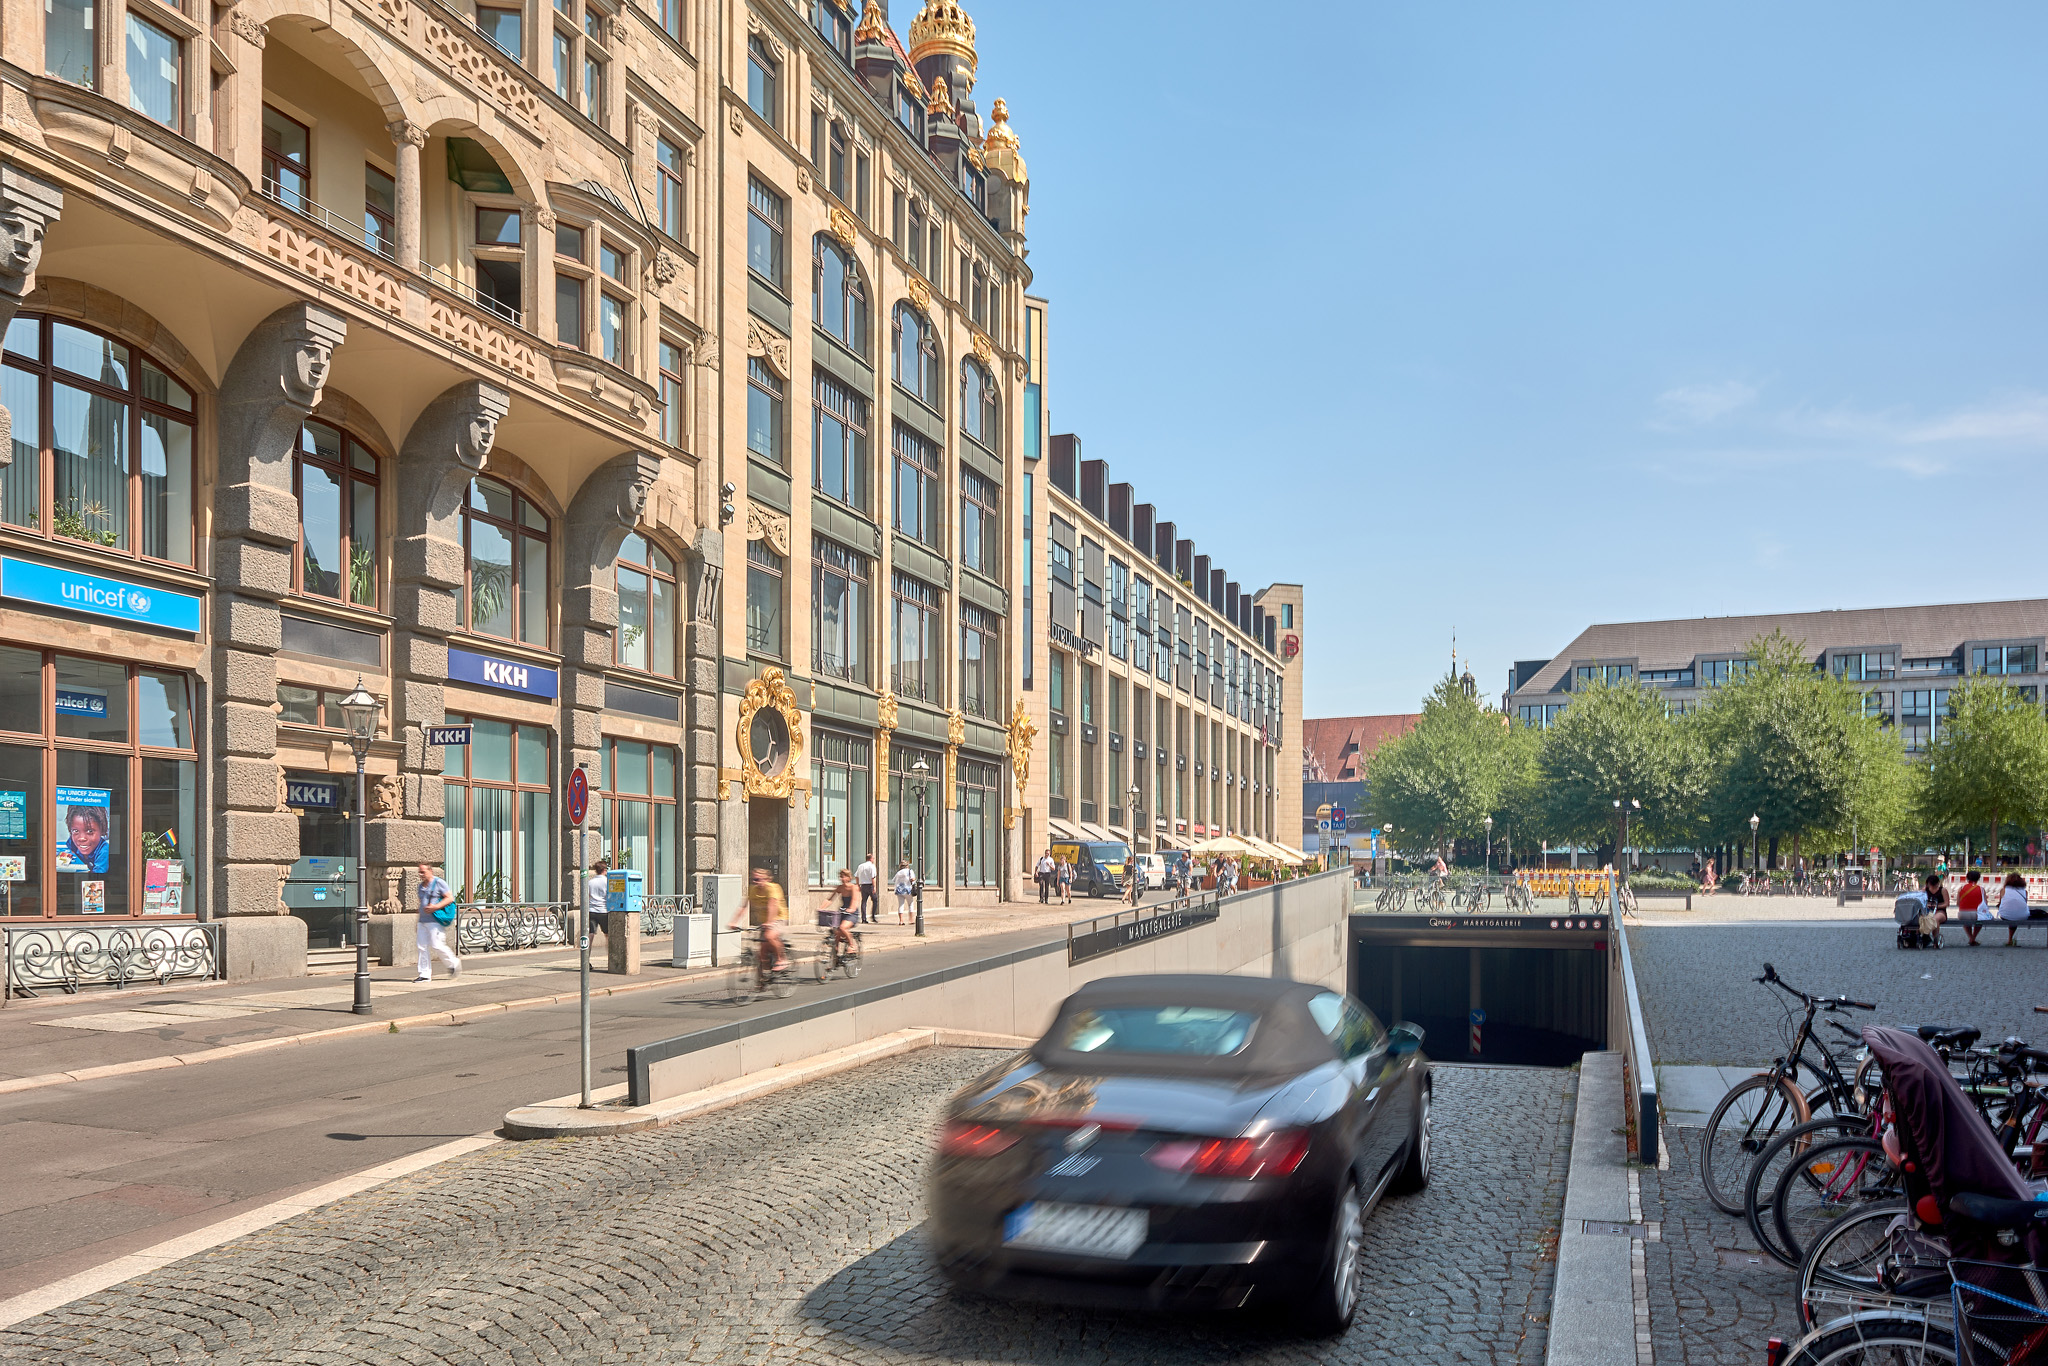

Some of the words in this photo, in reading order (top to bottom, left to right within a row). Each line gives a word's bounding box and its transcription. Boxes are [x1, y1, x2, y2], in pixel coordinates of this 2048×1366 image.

[62, 582, 125, 608] unicef
[1286, 635, 1299, 656] B
[484, 660, 528, 688] KKH
[434, 730, 466, 743] KKH
[289, 785, 331, 804] KKH
[1128, 913, 1182, 940] MARKTGALERIE
[1463, 919, 1521, 927] MARKTGALERIE
